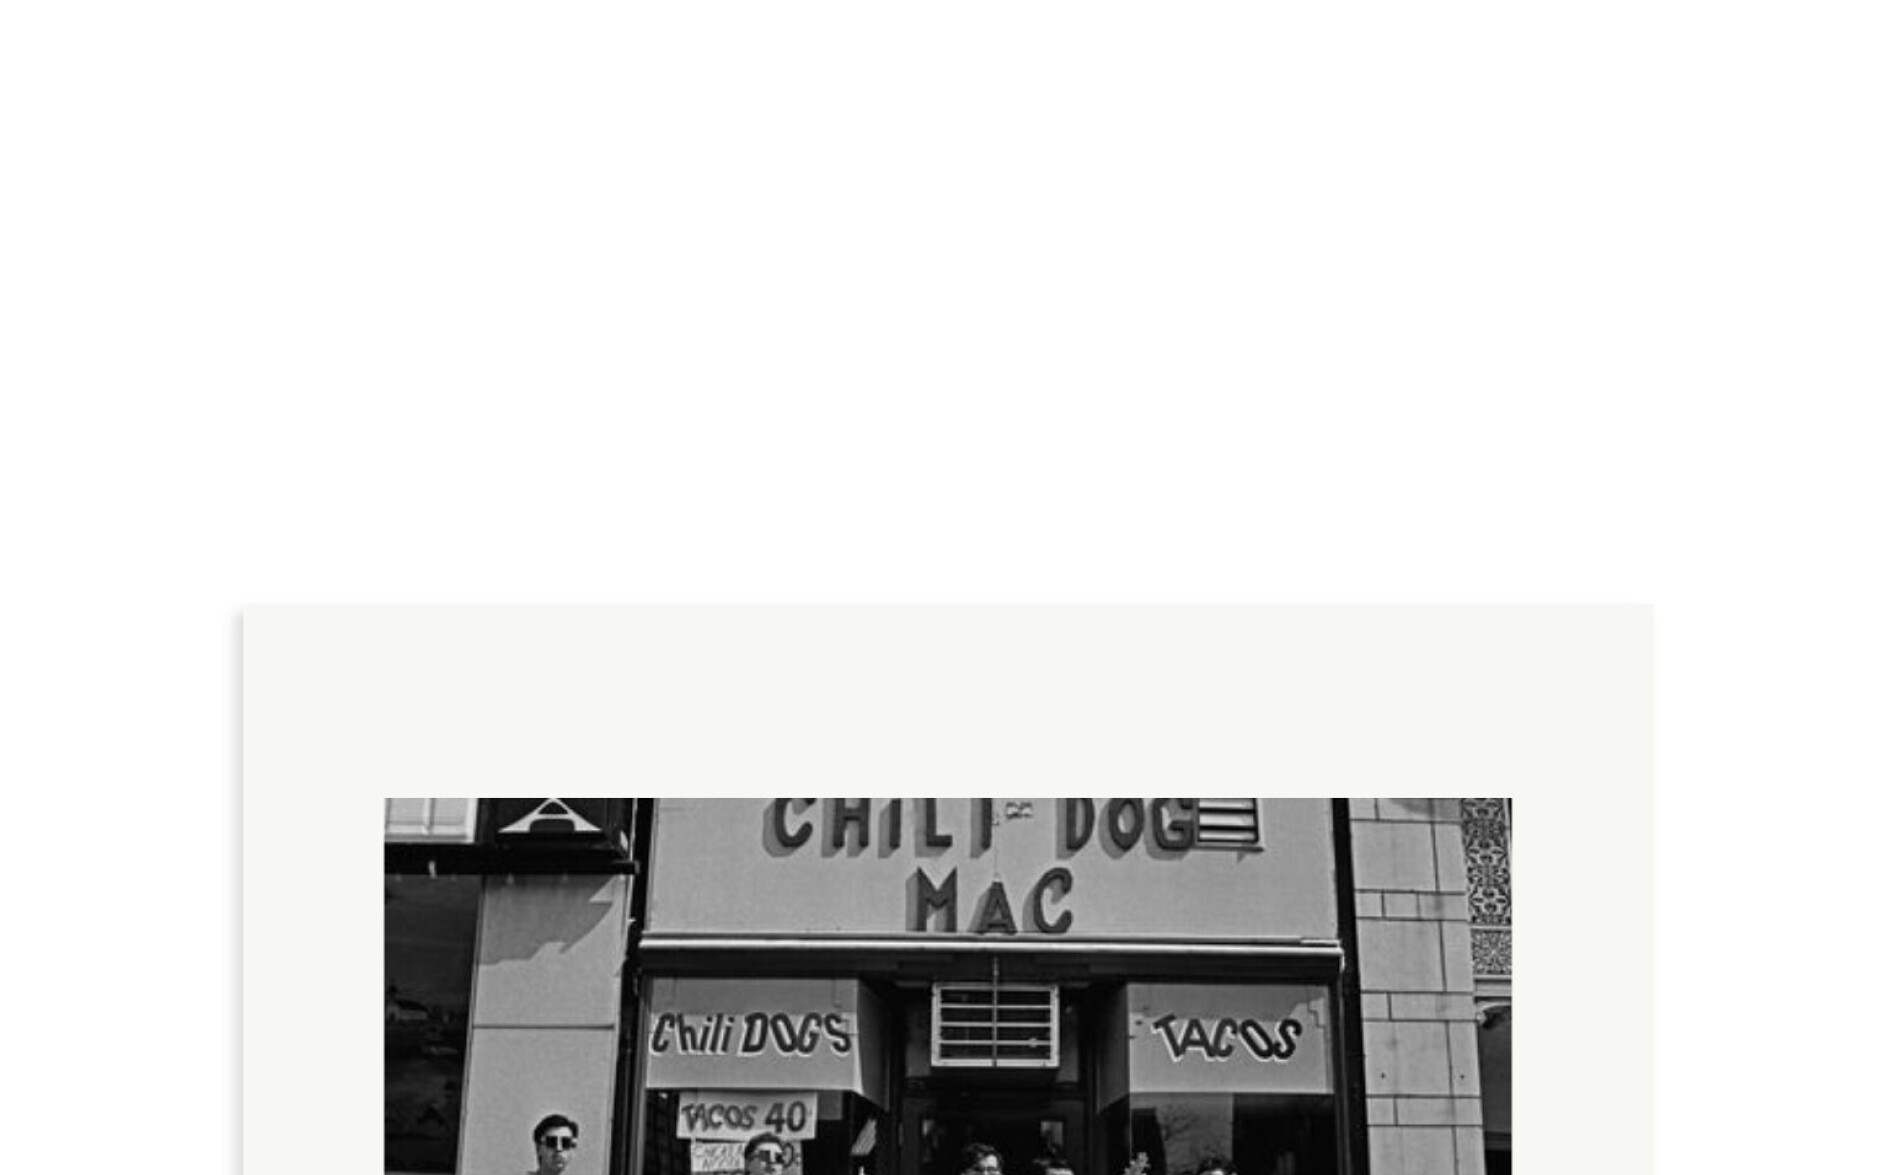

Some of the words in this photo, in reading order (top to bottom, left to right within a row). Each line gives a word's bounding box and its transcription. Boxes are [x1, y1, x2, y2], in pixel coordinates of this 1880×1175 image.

[763, 798, 993, 858] CHILI
[1056, 798, 1198, 859] DOG
[906, 867, 1073, 934] MAC
[651, 1012, 735, 1054] Chili
[740, 1012, 852, 1055] DOGS
[1152, 1014, 1303, 1061] TACOS
[680, 1102, 758, 1132] TACOS
